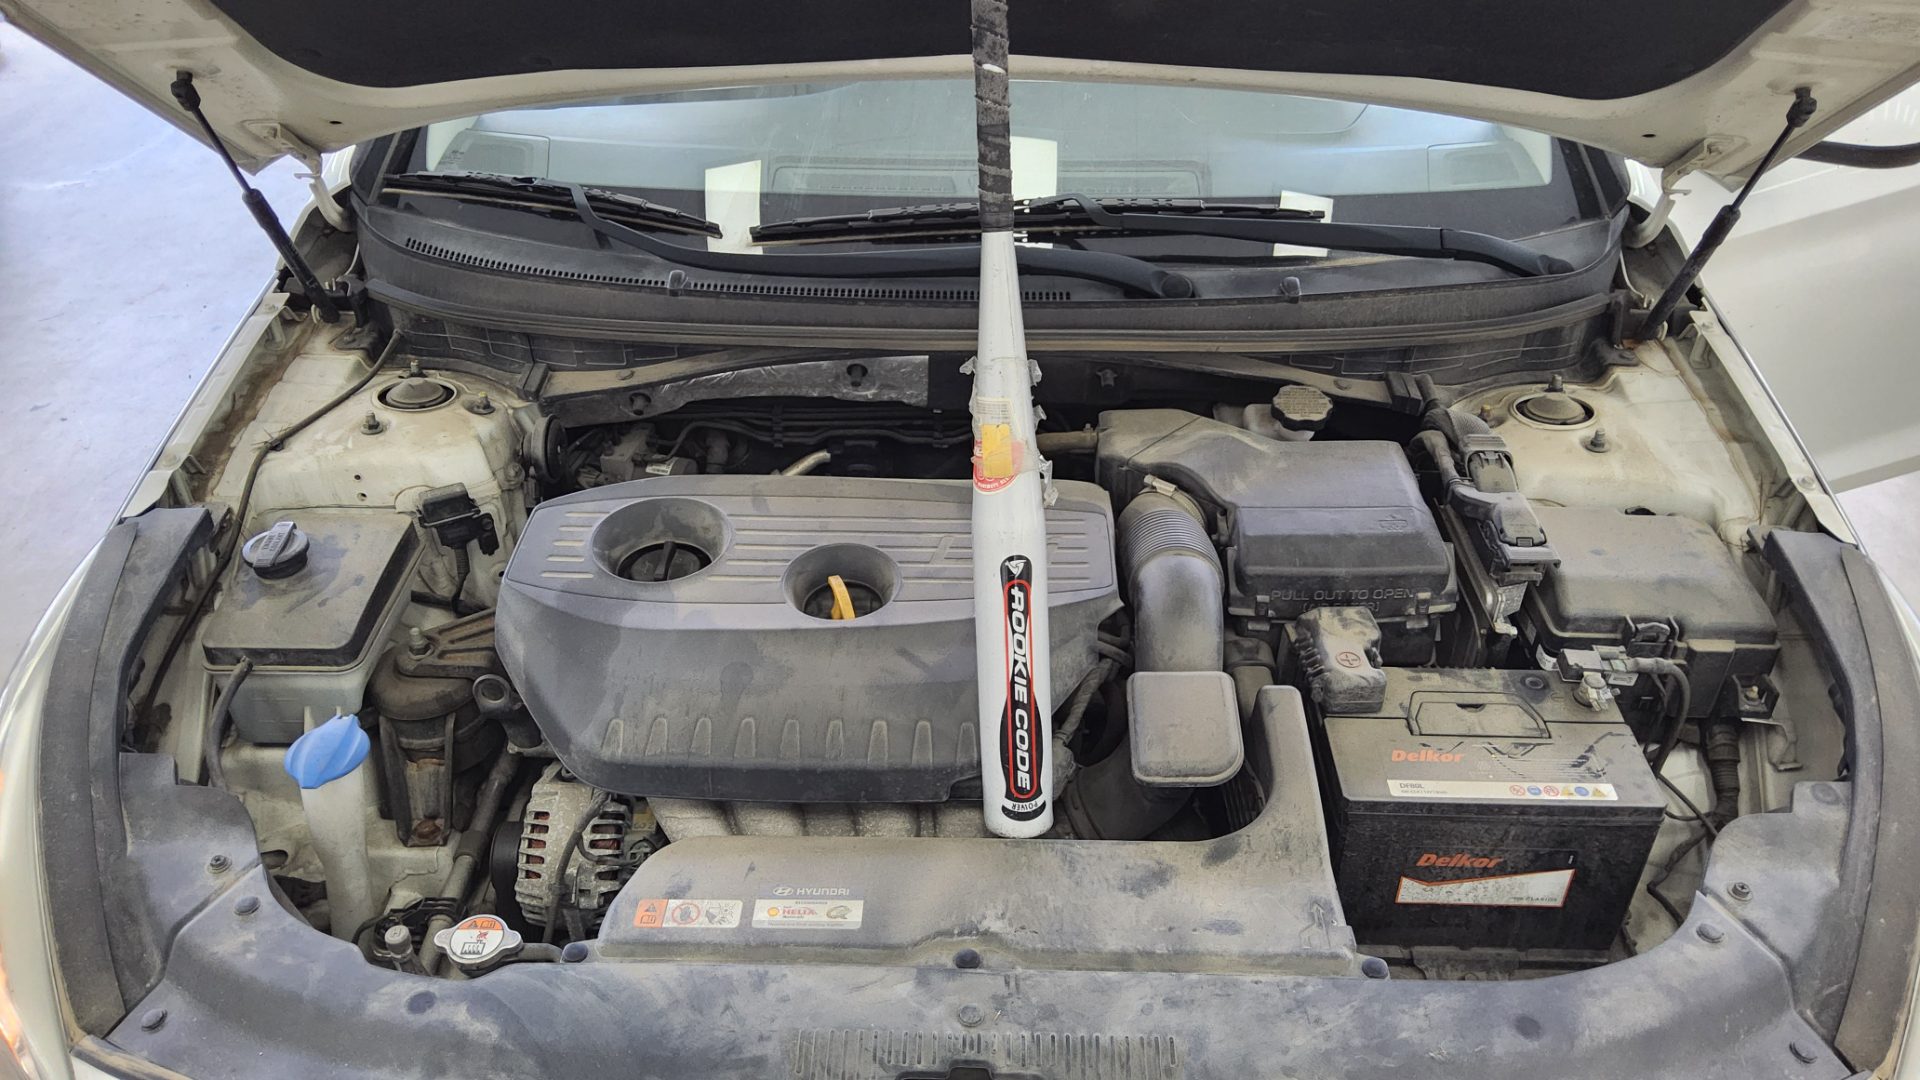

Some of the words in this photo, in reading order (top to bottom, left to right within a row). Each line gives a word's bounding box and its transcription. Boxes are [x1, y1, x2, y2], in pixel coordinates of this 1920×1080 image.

[1271, 590, 1310, 600] PULL
[1313, 590, 1346, 600] OUT
[1348, 589, 1370, 599] TO
[1372, 588, 1414, 599] OPEN
[1010, 587, 1027, 704] ROOKIE
[1014, 708, 1031, 790] CODE
[1391, 749, 1463, 762] Delkor
[1011, 800, 1038, 811] POWER
[1415, 853, 1504, 868] Delkor
[795, 887, 850, 896] HYUNDAI
